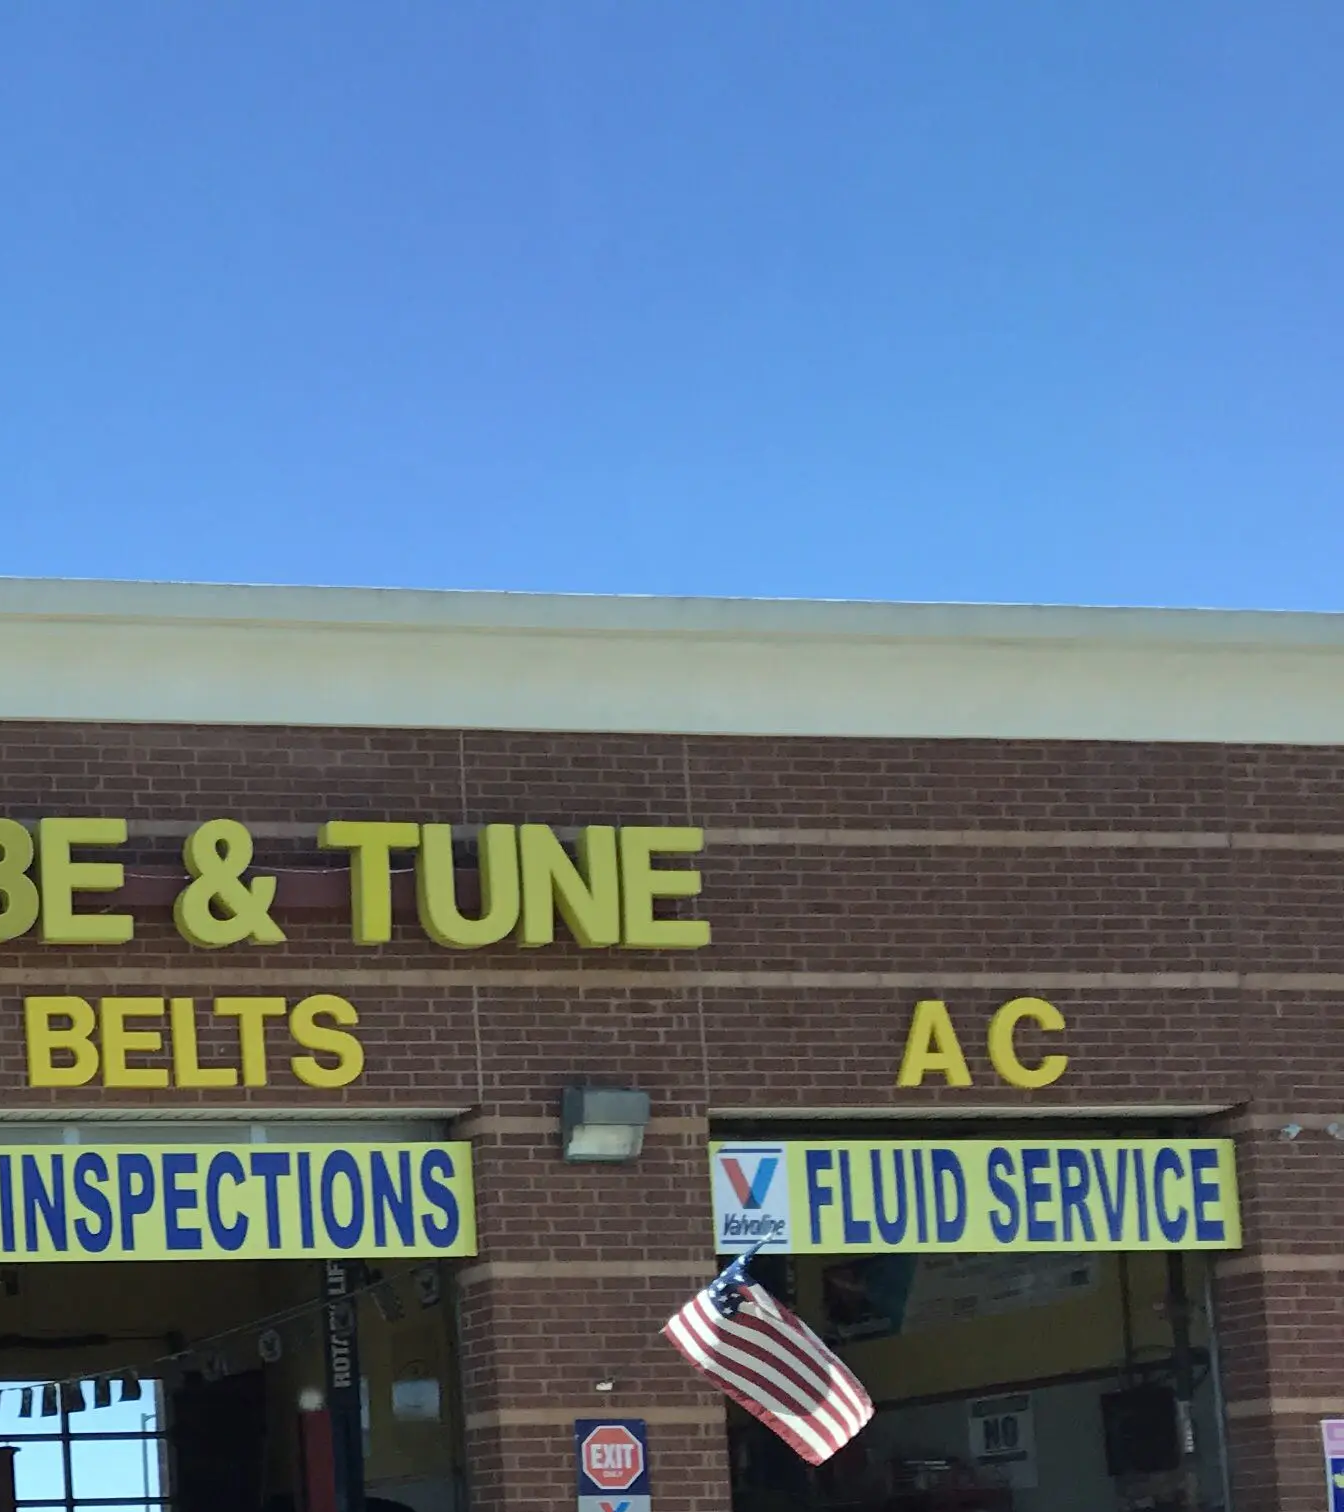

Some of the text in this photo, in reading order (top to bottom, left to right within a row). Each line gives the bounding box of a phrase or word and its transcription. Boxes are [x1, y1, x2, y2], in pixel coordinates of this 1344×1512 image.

[173, 817, 286, 948] &
[317, 820, 710, 950] TUNE
[23, 993, 366, 1090] BELTS
[805, 1147, 1224, 1245] FLUID SERVICE
[590, 1443, 634, 1469] EXIT
